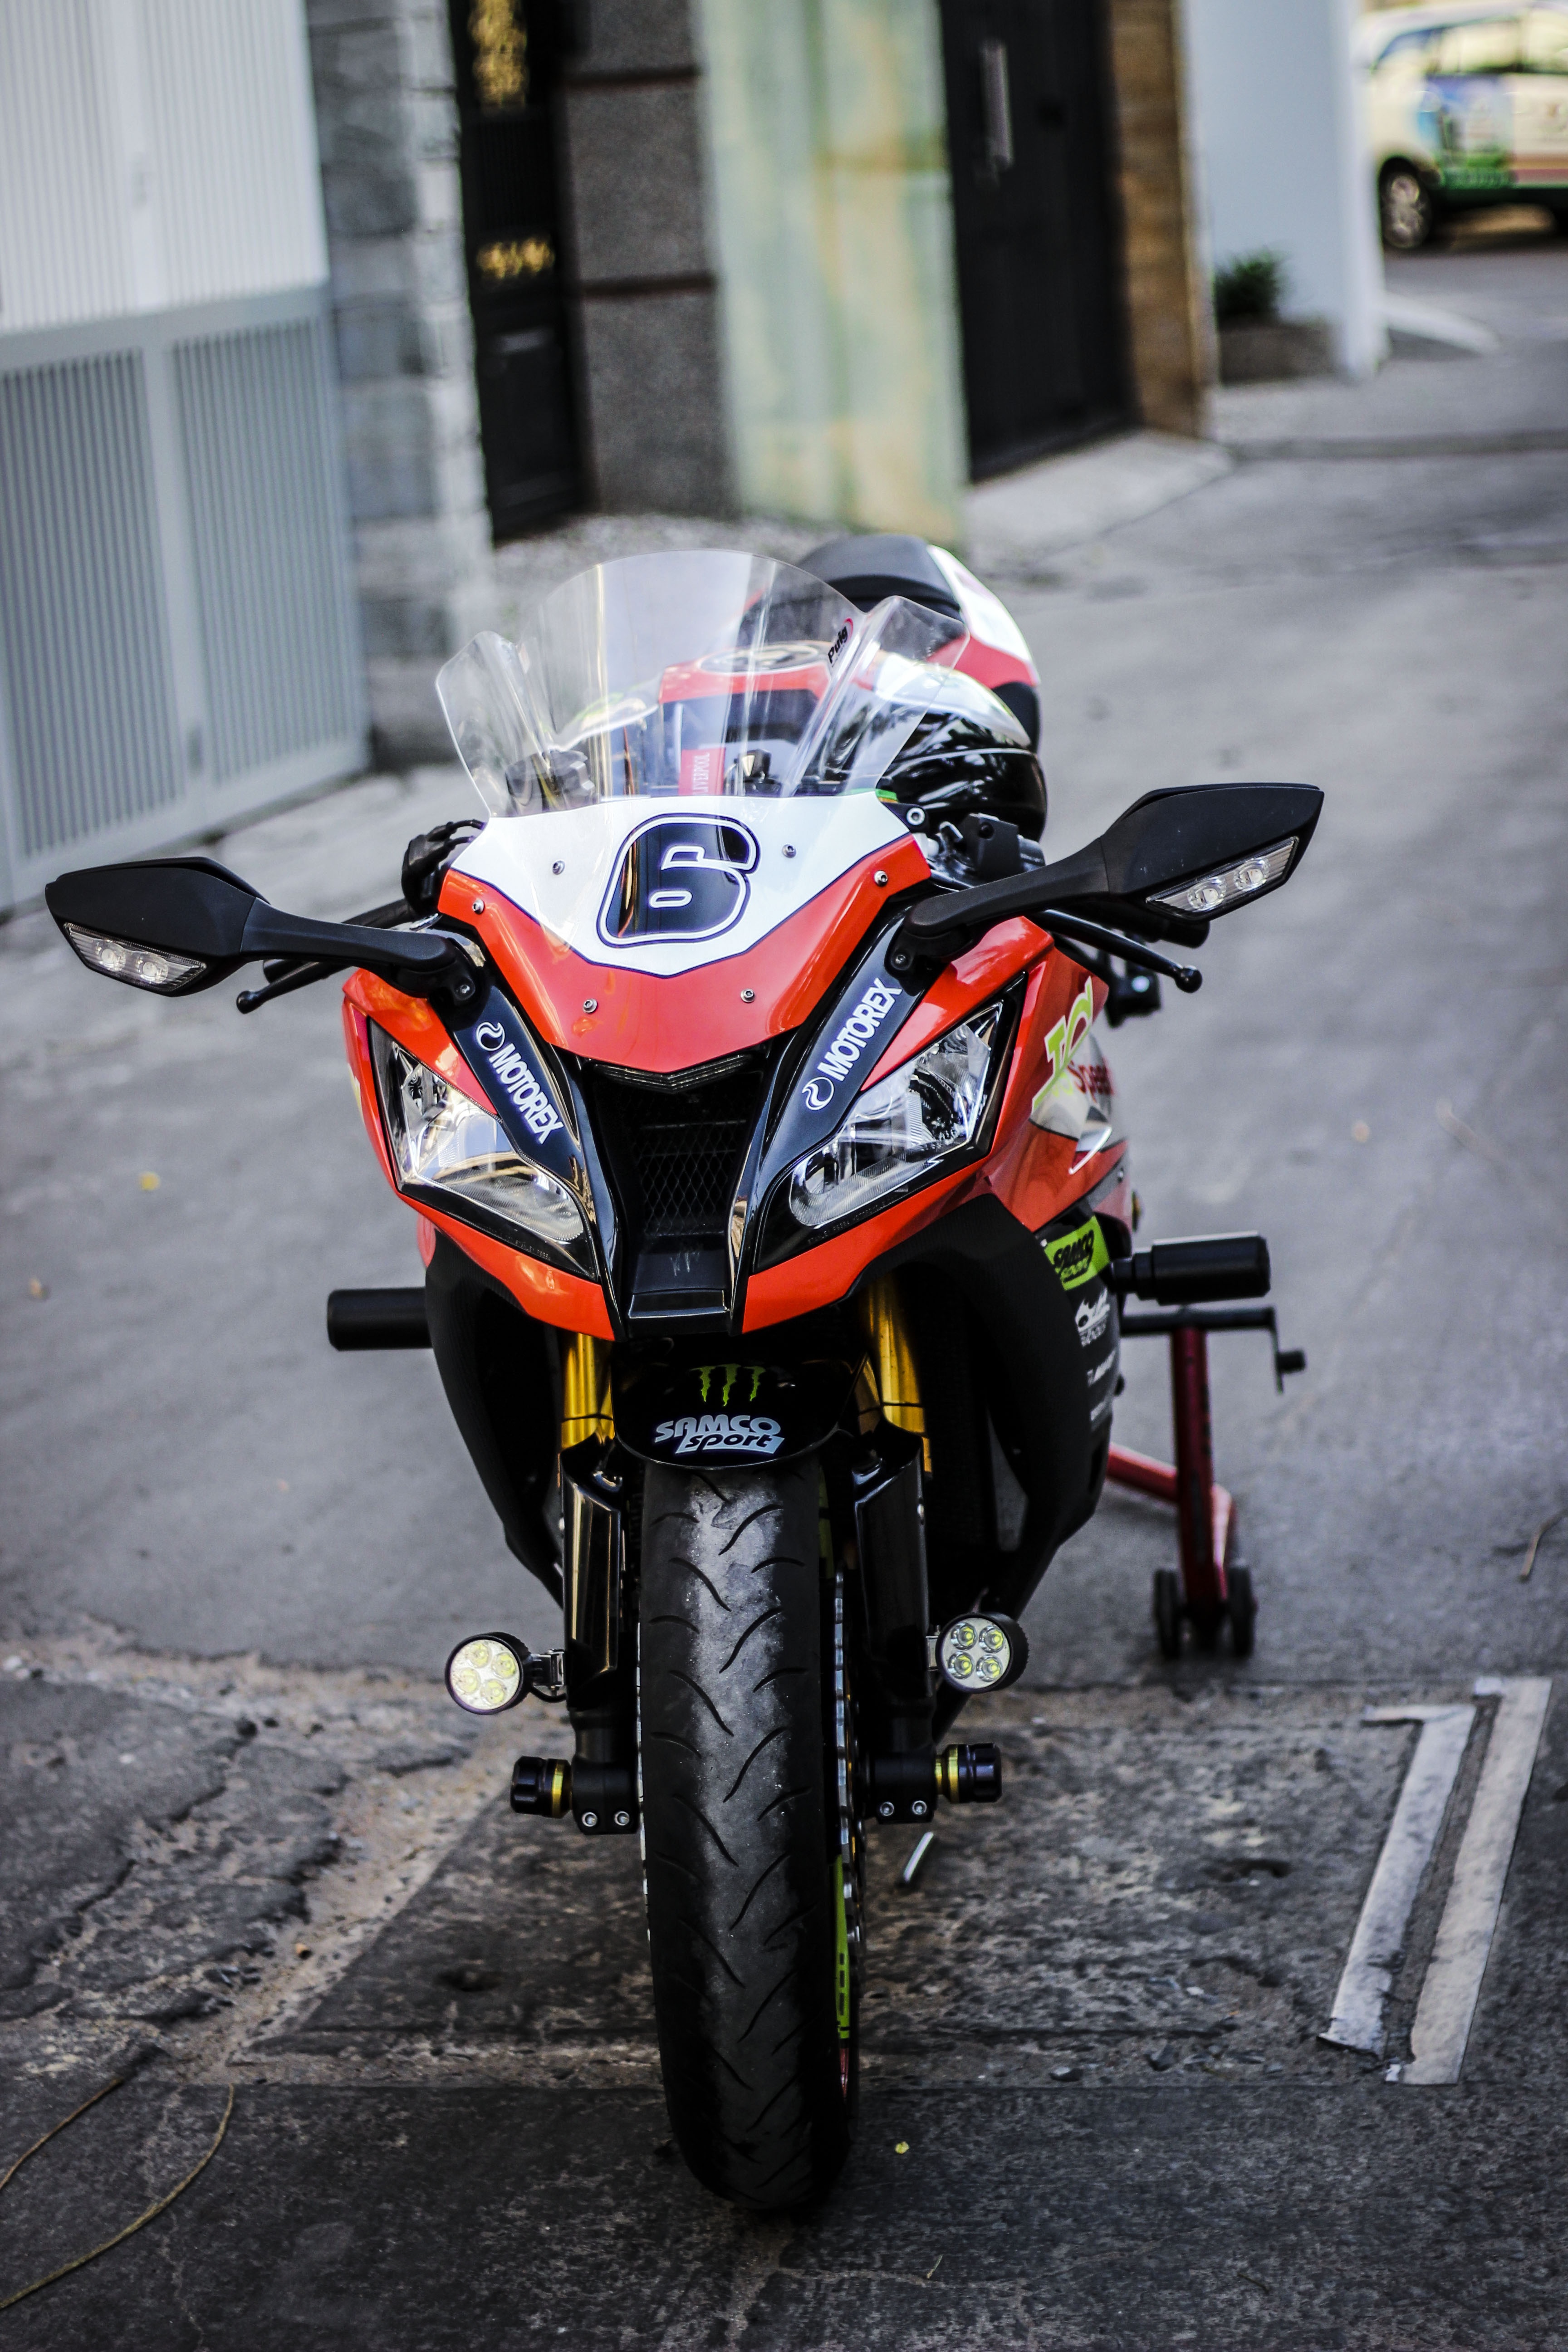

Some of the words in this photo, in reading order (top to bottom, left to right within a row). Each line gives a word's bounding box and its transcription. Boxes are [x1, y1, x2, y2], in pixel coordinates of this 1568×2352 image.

[828, 626, 848, 664] Puig
[692, 753, 710, 795] LIVERPOOL
[596, 813, 761, 948] 6
[817, 977, 902, 1082] MOTOREX
[489, 1043, 564, 1144] MOTOREX
[655, 1414, 781, 1443] SAMCO
[684, 1434, 773, 1451] sport
